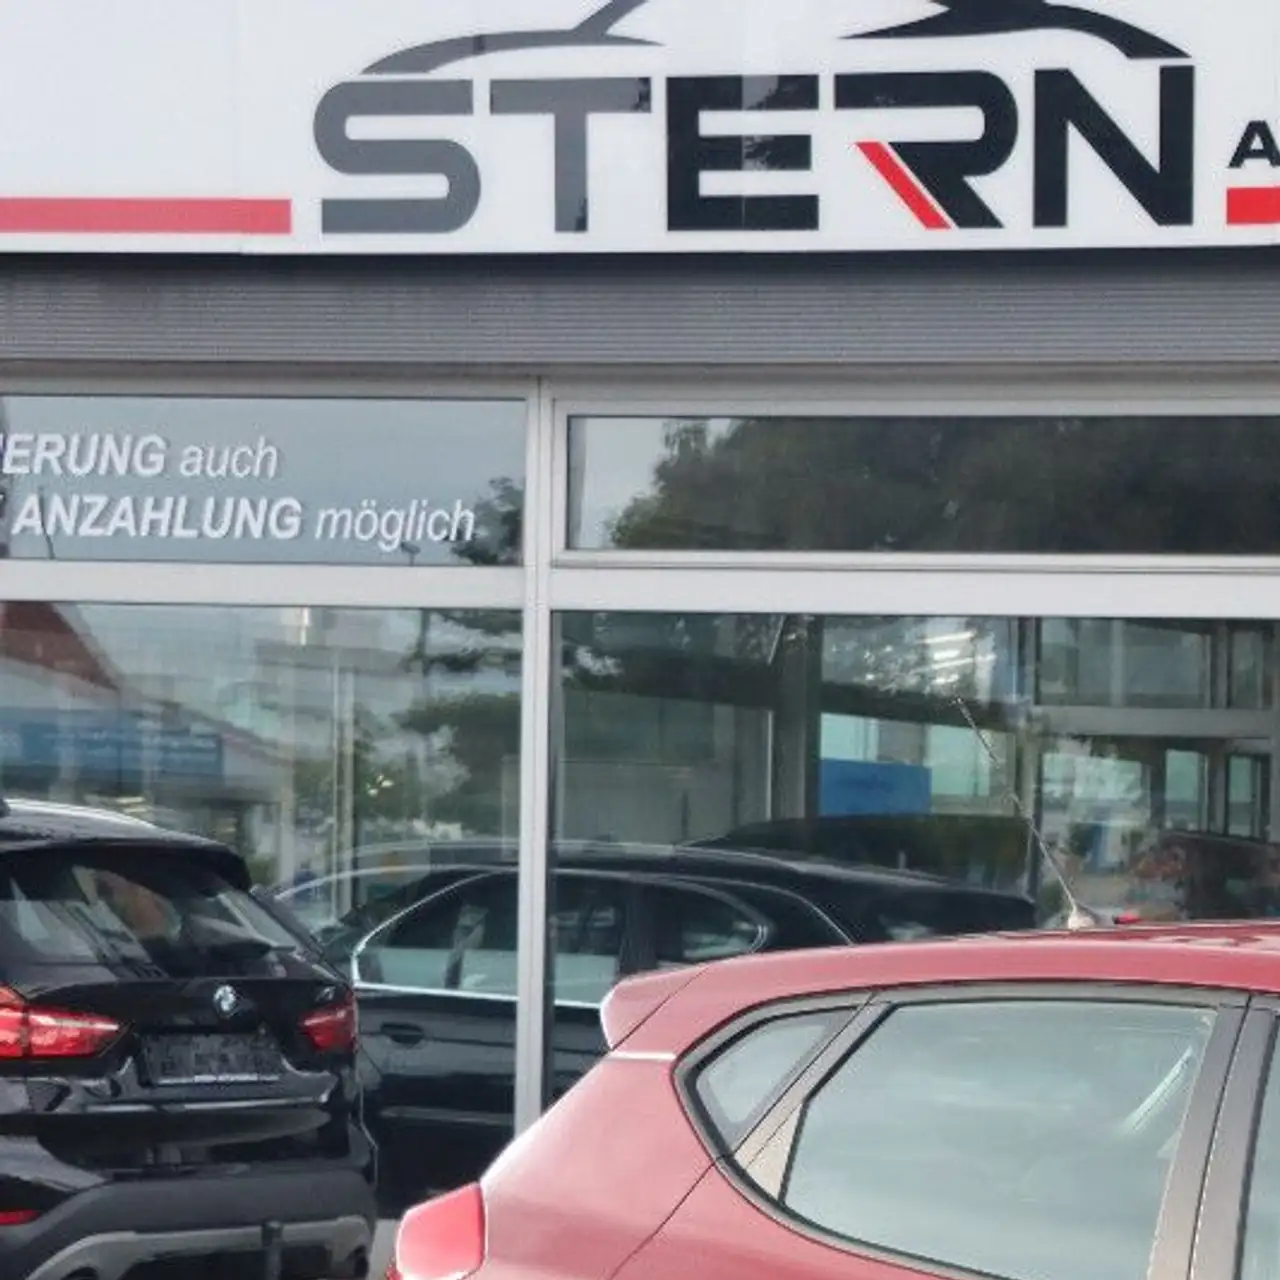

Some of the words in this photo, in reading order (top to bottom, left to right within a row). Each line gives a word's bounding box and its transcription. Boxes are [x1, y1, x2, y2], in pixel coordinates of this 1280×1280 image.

[312, 65, 1195, 234] STERN
[0, 432, 168, 477] ERUNG
[179, 435, 278, 478] auch
[11, 492, 302, 540] ANZAHLUNG
[315, 498, 477, 551] möglich
